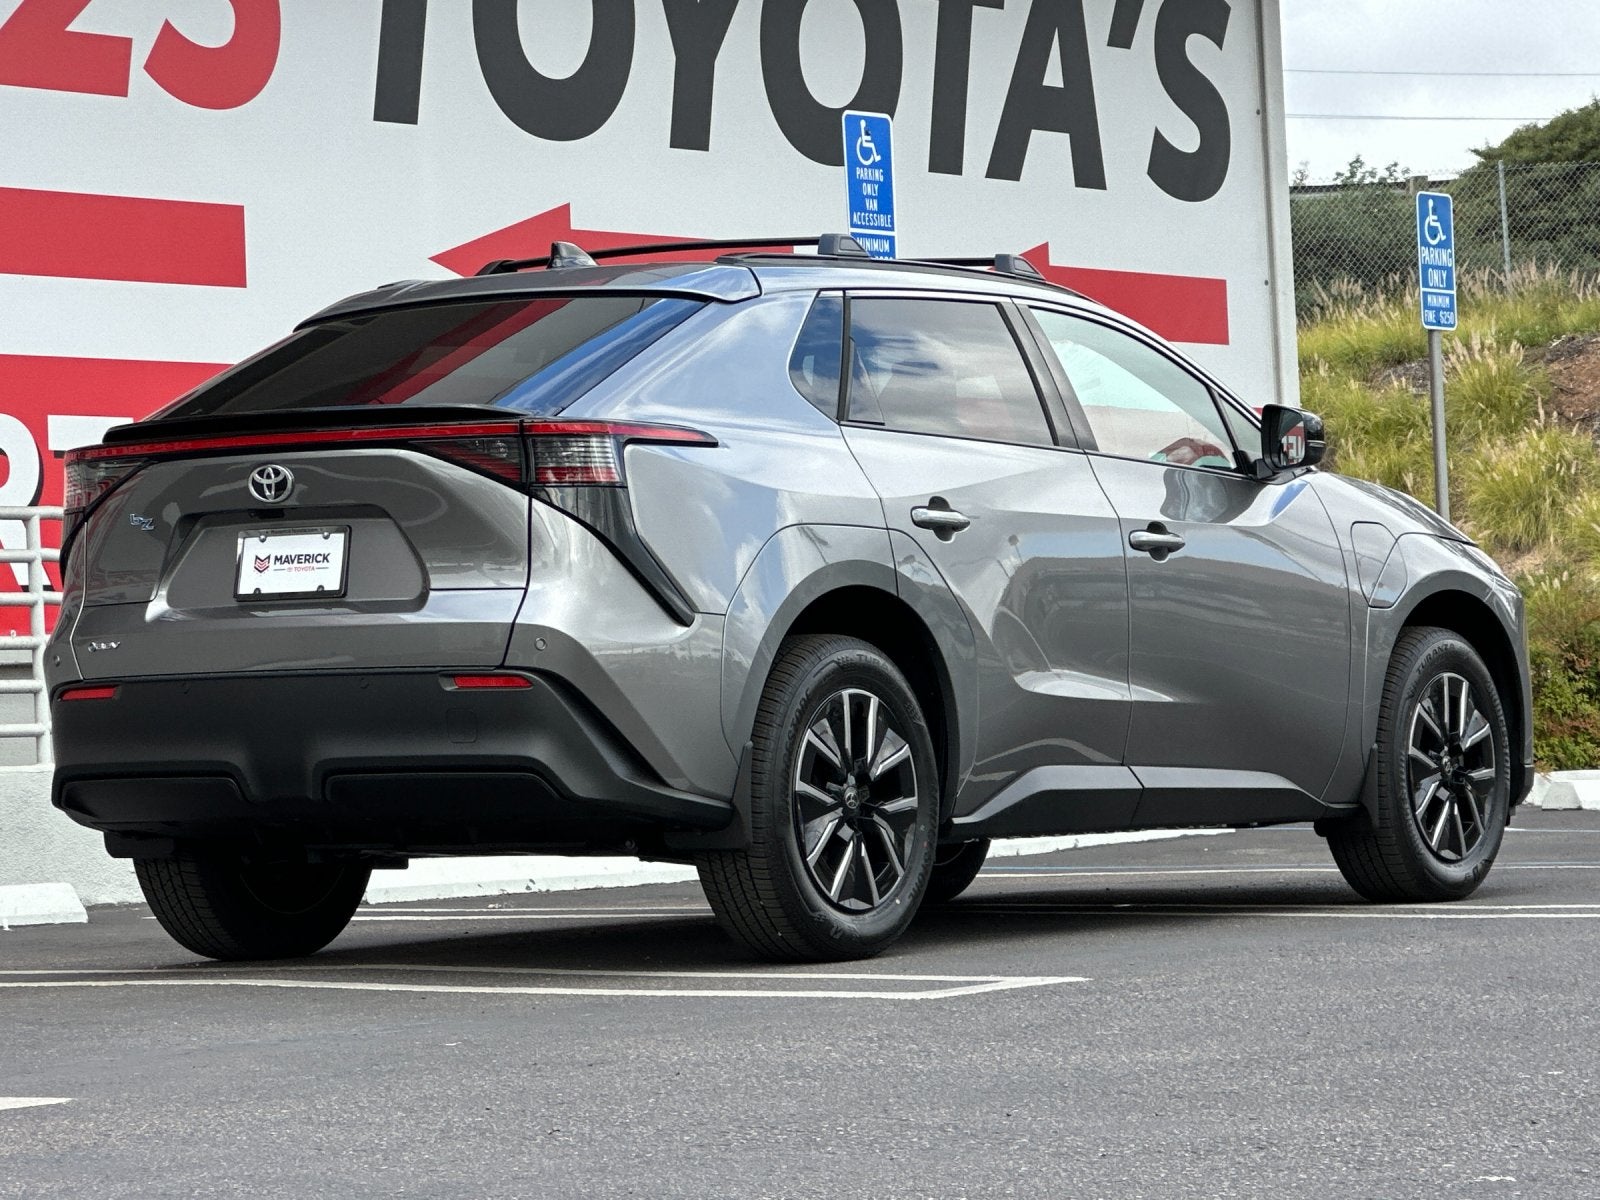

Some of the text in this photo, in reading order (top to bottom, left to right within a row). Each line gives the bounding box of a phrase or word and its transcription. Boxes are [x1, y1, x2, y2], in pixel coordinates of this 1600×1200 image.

[856, 167, 884, 182] PARKING
[862, 184, 879, 196] ONLY
[865, 198, 878, 211] VAN
[853, 212, 892, 227] ACCESSIBLE
[857, 237, 890, 253] MINIMUM
[1421, 246, 1453, 267] PARKING
[1428, 268, 1447, 288] ONLY
[1427, 294, 1450, 308] MINIMUM
[1425, 309, 1454, 325] FINE $250
[273, 553, 331, 565] MAVERICK
